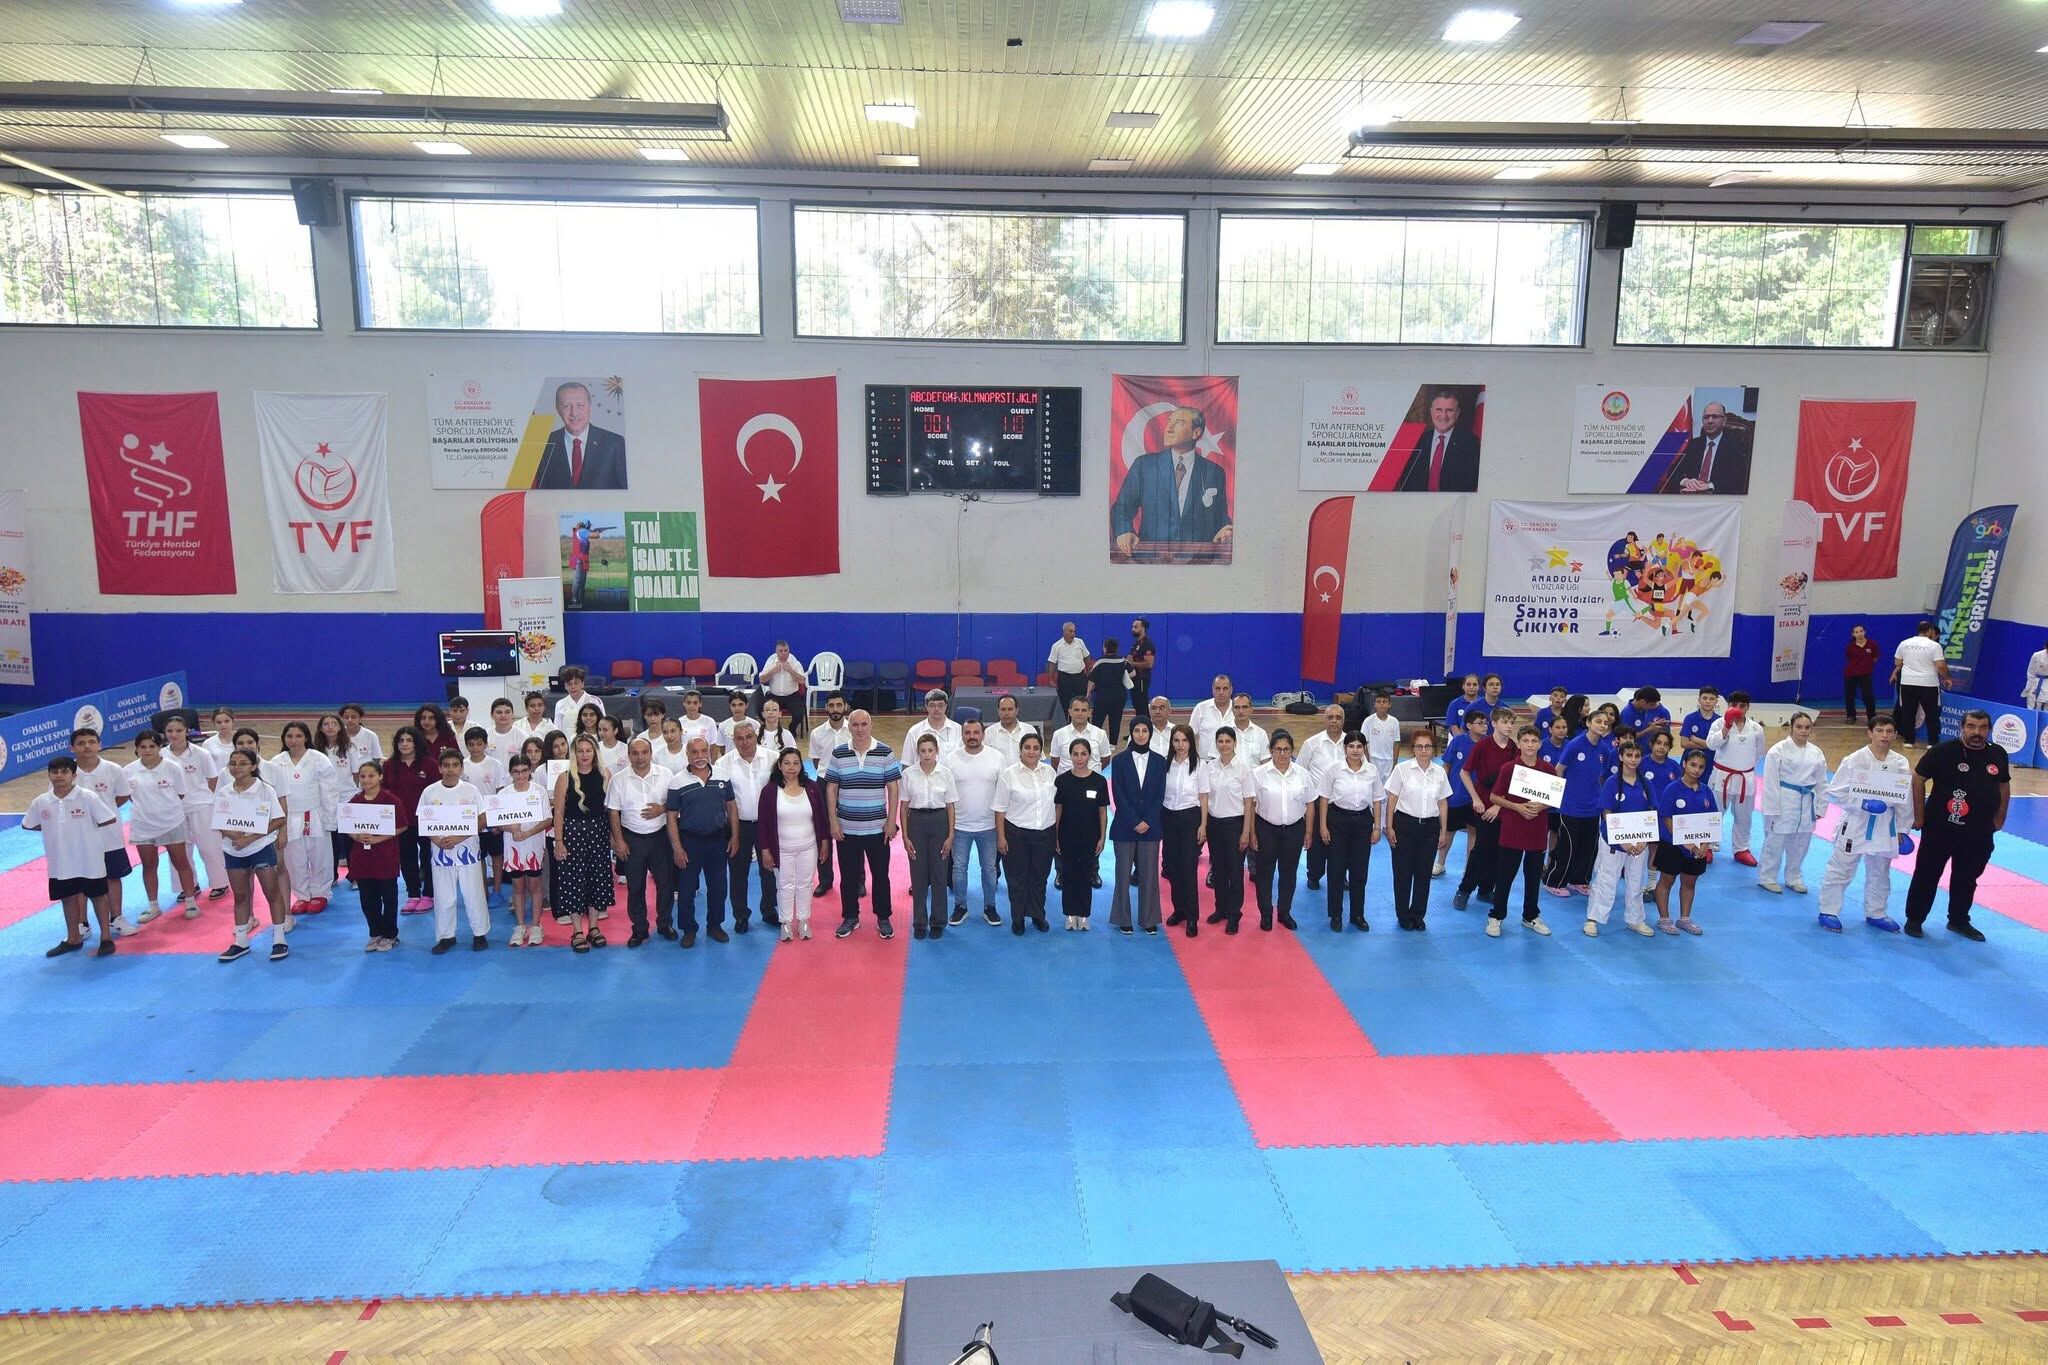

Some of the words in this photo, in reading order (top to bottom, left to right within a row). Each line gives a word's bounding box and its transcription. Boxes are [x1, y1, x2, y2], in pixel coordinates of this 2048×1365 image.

[433, 417, 453, 426] TÜM
[455, 417, 503, 426] ANTRENÖR
[504, 418, 516, 426] VE
[1311, 422, 1328, 430] TÜM
[1330, 422, 1374, 431] ANTRENÖR
[436, 427, 513, 435] SPORCULARIMIZA
[1312, 431, 1382, 439] SPORCULARIMIZA
[432, 437, 475, 445] BAŞARILAR
[476, 436, 518, 444] DİLİYORUM
[1307, 440, 1346, 448] BAŞARILAR
[1347, 440, 1386, 448] DİLİYORUM
[122, 511, 198, 536] THF
[1817, 512, 1886, 542] TVF
[288, 520, 373, 553] TVF
[631, 521, 661, 544] TAM
[124, 540, 160, 550] Türkiye
[162, 540, 200, 548] Hentbol
[133, 549, 195, 558] Federasyonu
[632, 546, 692, 571] İSABETE
[633, 575, 699, 598] ODAKLAN
[1969, 549, 1999, 632] GİRİYORUZ
[1495, 594, 1557, 603] Anadolu'nun
[1561, 595, 1604, 604] Yıldızları
[1944, 552, 1990, 660] HAREKETLİ
[1513, 619, 1579, 637] ÇIKIYOR
[1939, 608, 1957, 646] AZA
[509, 636, 515, 644] 0
[509, 649, 515, 657] 0
[117, 694, 147, 708] OSMANİYE
[108, 709, 135, 721] GENÇLİK
[142, 702, 158, 712] SPOR
[22, 719, 59, 736] OSMANİYE
[11, 735, 45, 752] GENÇLİK
[44, 734, 53, 742] VE
[53, 728, 71, 740] SPOR
[25, 739, 69, 760] MÜDÜRLÜĞÜ
[1521, 786, 1550, 800] ISPARTA
[1852, 787, 1906, 800] KAHRAMANMARAŞ
[497, 811, 533, 821] ANTALYA
[226, 819, 255, 827] ADANA
[1615, 832, 1653, 841] OSMANİYE
[1684, 832, 1711, 840] MERSİN
